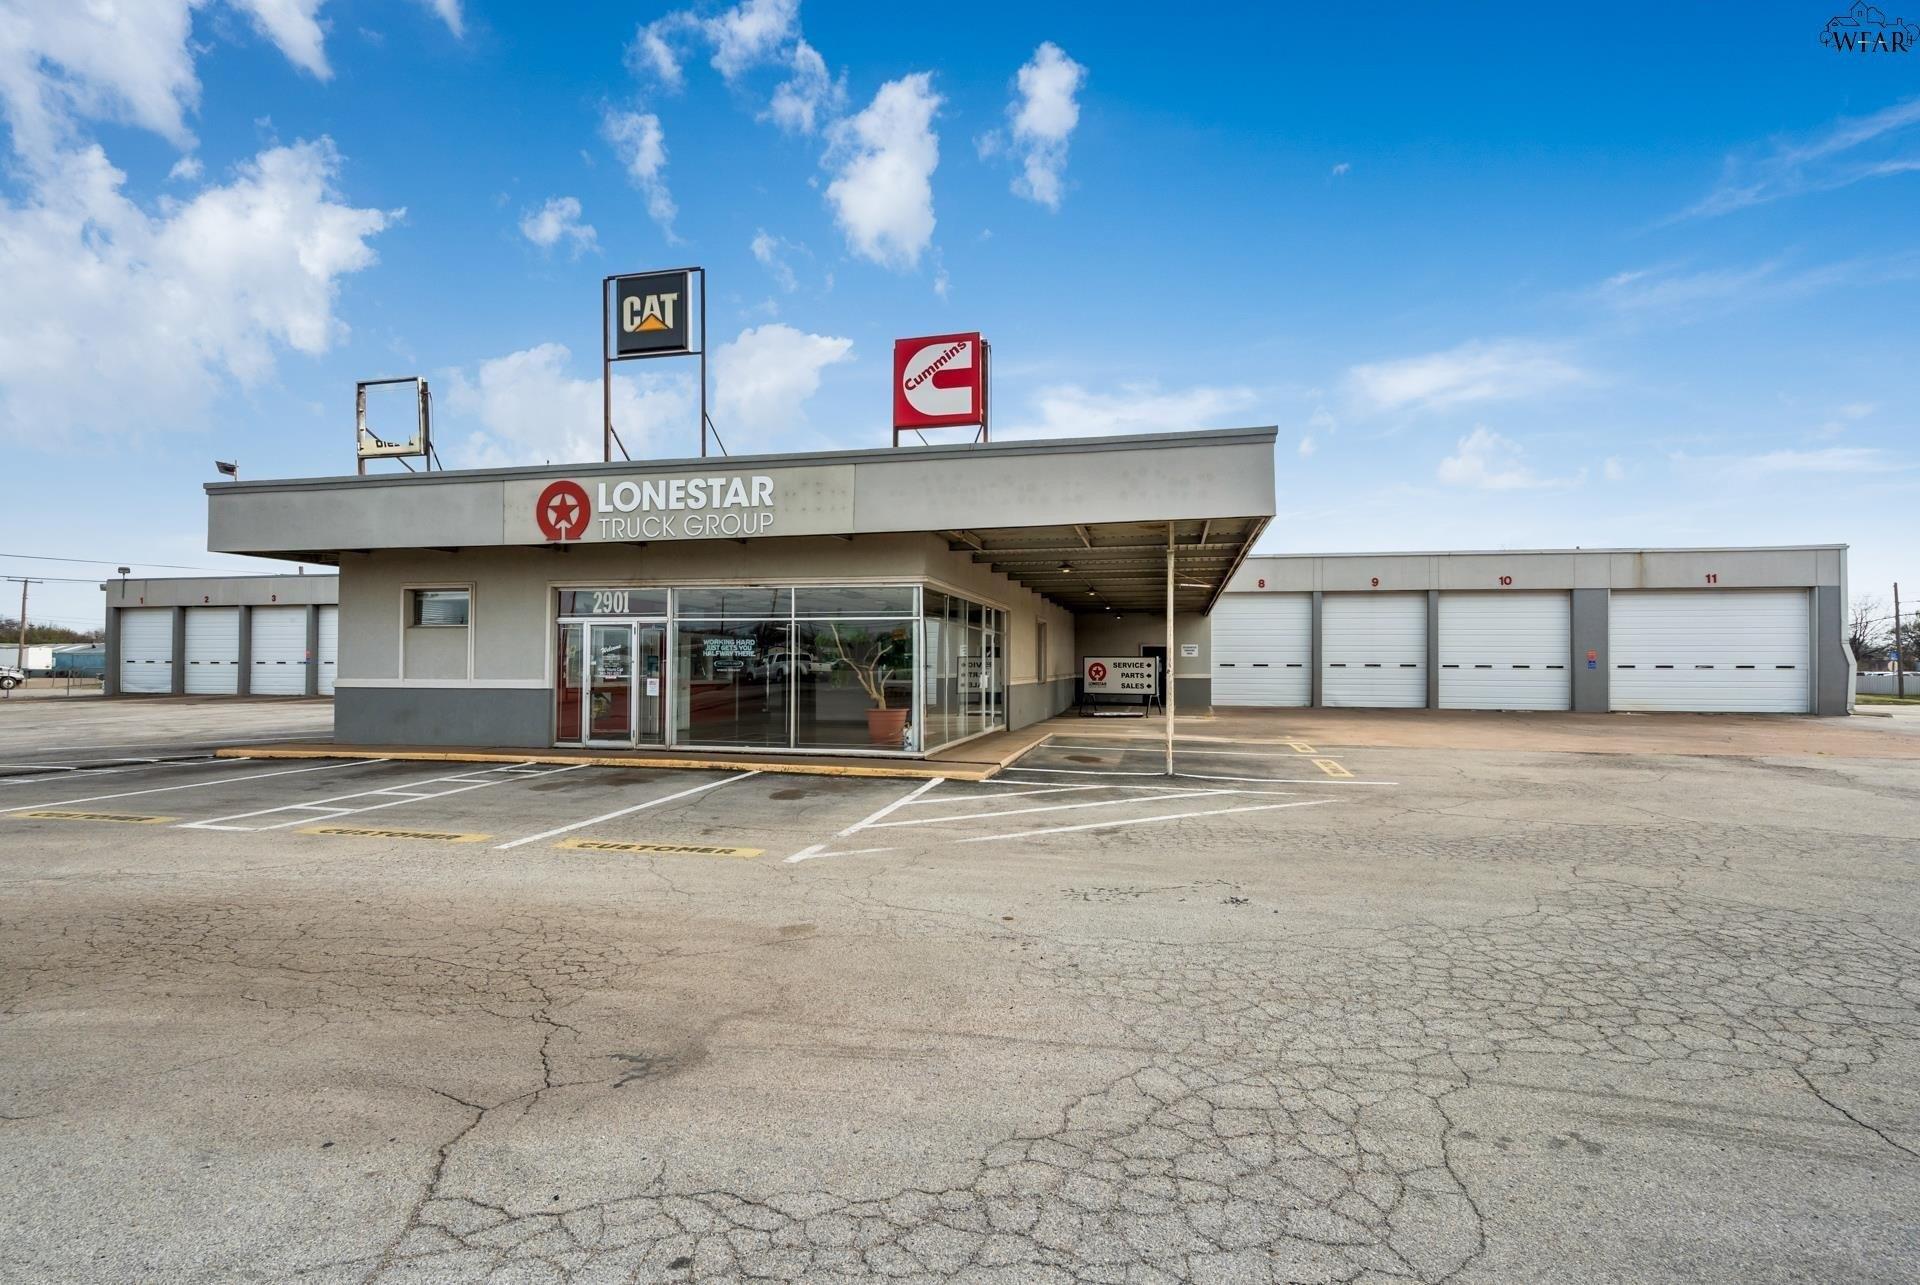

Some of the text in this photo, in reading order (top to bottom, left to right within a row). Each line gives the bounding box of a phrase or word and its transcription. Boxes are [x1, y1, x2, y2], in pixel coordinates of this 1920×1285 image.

[623, 293, 678, 333] CAT
[904, 341, 967, 391] Cummins
[597, 476, 774, 513] LONESTAR
[599, 512, 774, 539] TRUCK GROUP
[1258, 579, 1265, 588] 8
[1371, 577, 1379, 587] 9
[1498, 576, 1512, 586] 10
[1705, 574, 1717, 584] 11
[271, 594, 276, 602] 3
[592, 591, 630, 613] 2901
[319, 828, 462, 840] CUSTOMER
[577, 842, 736, 855] CUSTOMER
